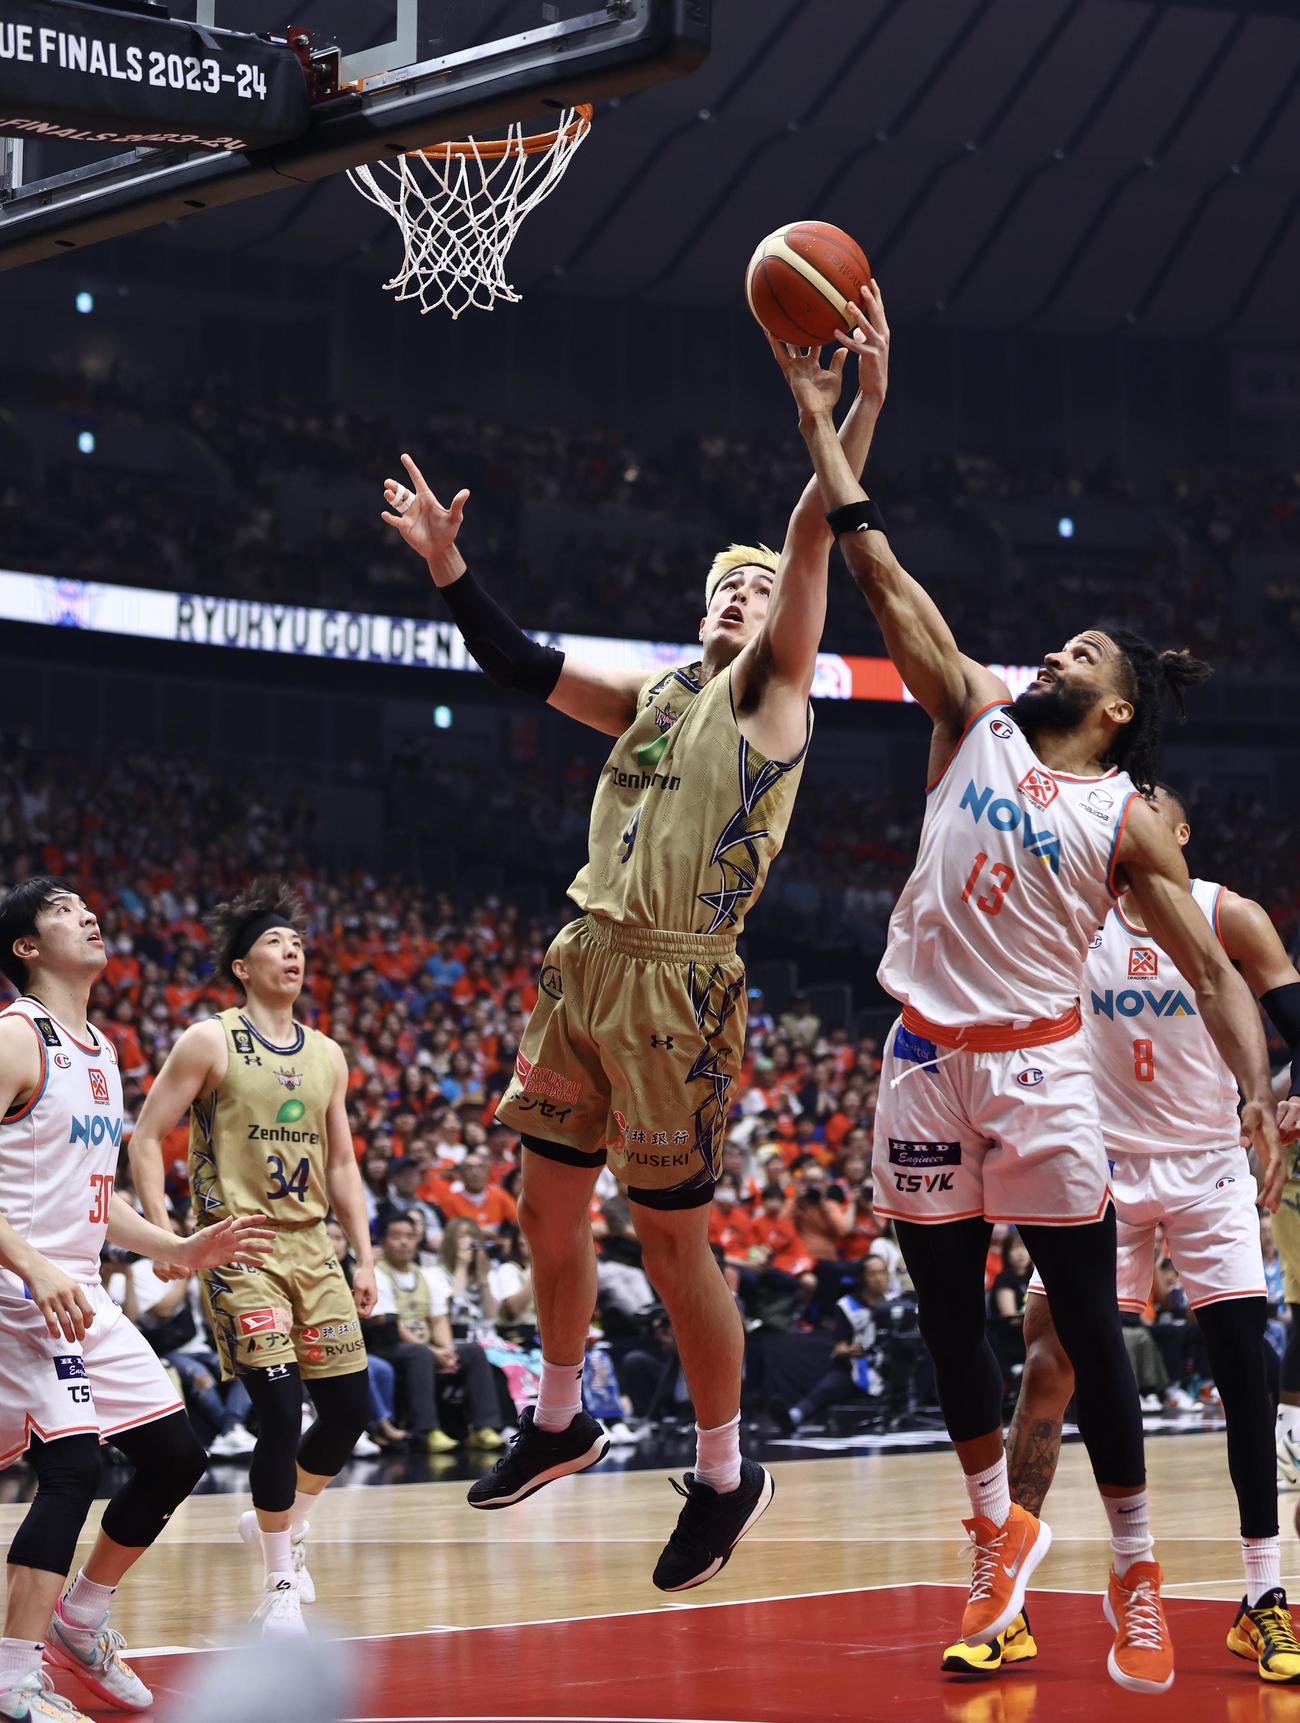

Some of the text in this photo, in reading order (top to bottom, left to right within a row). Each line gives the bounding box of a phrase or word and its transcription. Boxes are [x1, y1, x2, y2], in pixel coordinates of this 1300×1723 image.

[40, 28, 143, 82] FINALS
[149, 51, 268, 100] 2023-24
[2, 118, 117, 142] FINALS
[176, 599, 311, 656] RYUKYU
[320, 608, 453, 671] GOLDEN
[960, 778, 1060, 876] NOVA
[960, 851, 1015, 917] 13
[1090, 989, 1197, 1022] NOVA
[529, 1066, 582, 1095] RYUKYU
[1133, 1039, 1154, 1082] 8
[89, 1174, 115, 1224] 30
[266, 1156, 310, 1203] 34
